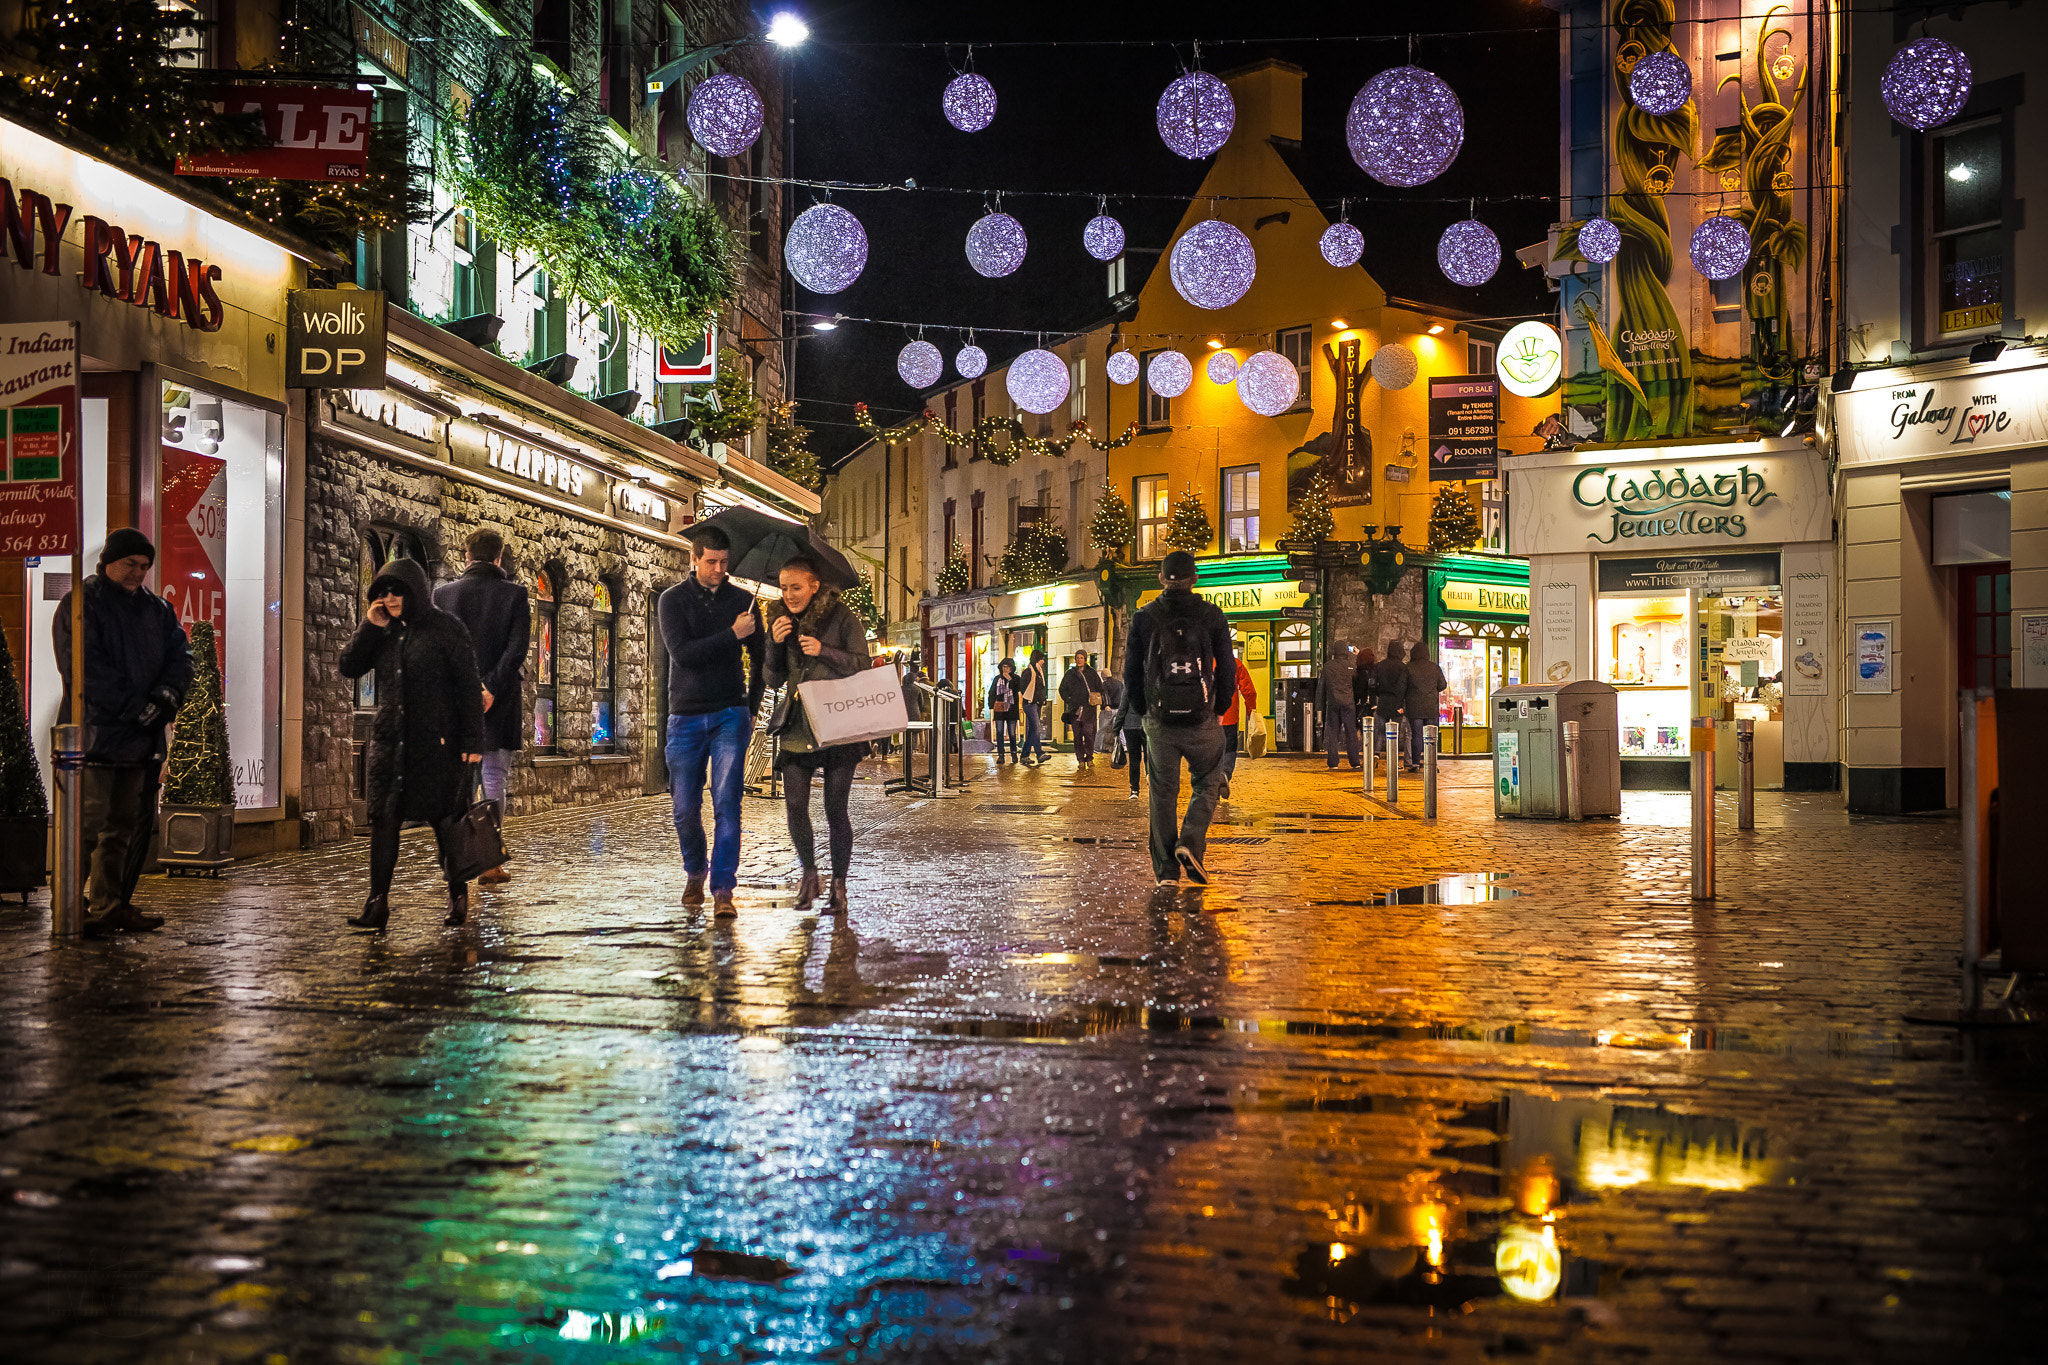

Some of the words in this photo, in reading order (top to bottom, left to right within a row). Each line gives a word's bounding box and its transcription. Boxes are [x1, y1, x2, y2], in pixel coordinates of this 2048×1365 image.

[200, 101, 367, 151] ALE
[195, 165, 260, 175] anthonyryans.com
[328, 168, 360, 177] RYANS
[82, 215, 224, 332] RYANS
[303, 302, 366, 335] wallis
[6, 332, 75, 355] Indian
[1621, 328, 1679, 345] Claddagh
[1625, 342, 1670, 354] Jewellers
[300, 348, 366, 375] DP
[1458, 386, 1473, 394] FOR
[1475, 385, 1493, 393] SALE
[1892, 389, 1917, 400] FROM
[1972, 395, 1997, 406] WITH
[1346, 345, 1355, 483] EVERGREEN
[1891, 388, 1957, 440] Galway
[1448, 427, 1462, 435] 091
[1465, 426, 1493, 434] 567391
[1454, 447, 1494, 456] ROONEY
[43, 485, 77, 500] Walk
[1573, 464, 1777, 515] Claddagh
[0, 509, 46, 528] alway
[1587, 510, 1746, 544] Jewellers
[2, 536, 33, 552] 564
[39, 534, 68, 550] 831
[1274, 590, 1298, 600] STORE
[1447, 591, 1473, 600] HEALTH
[1478, 588, 1529, 610] EVERGR
[1731, 640, 1770, 649] Claddagh
[823, 691, 897, 714] TOPSHOP
[1530, 713, 1547, 721] LITTER
